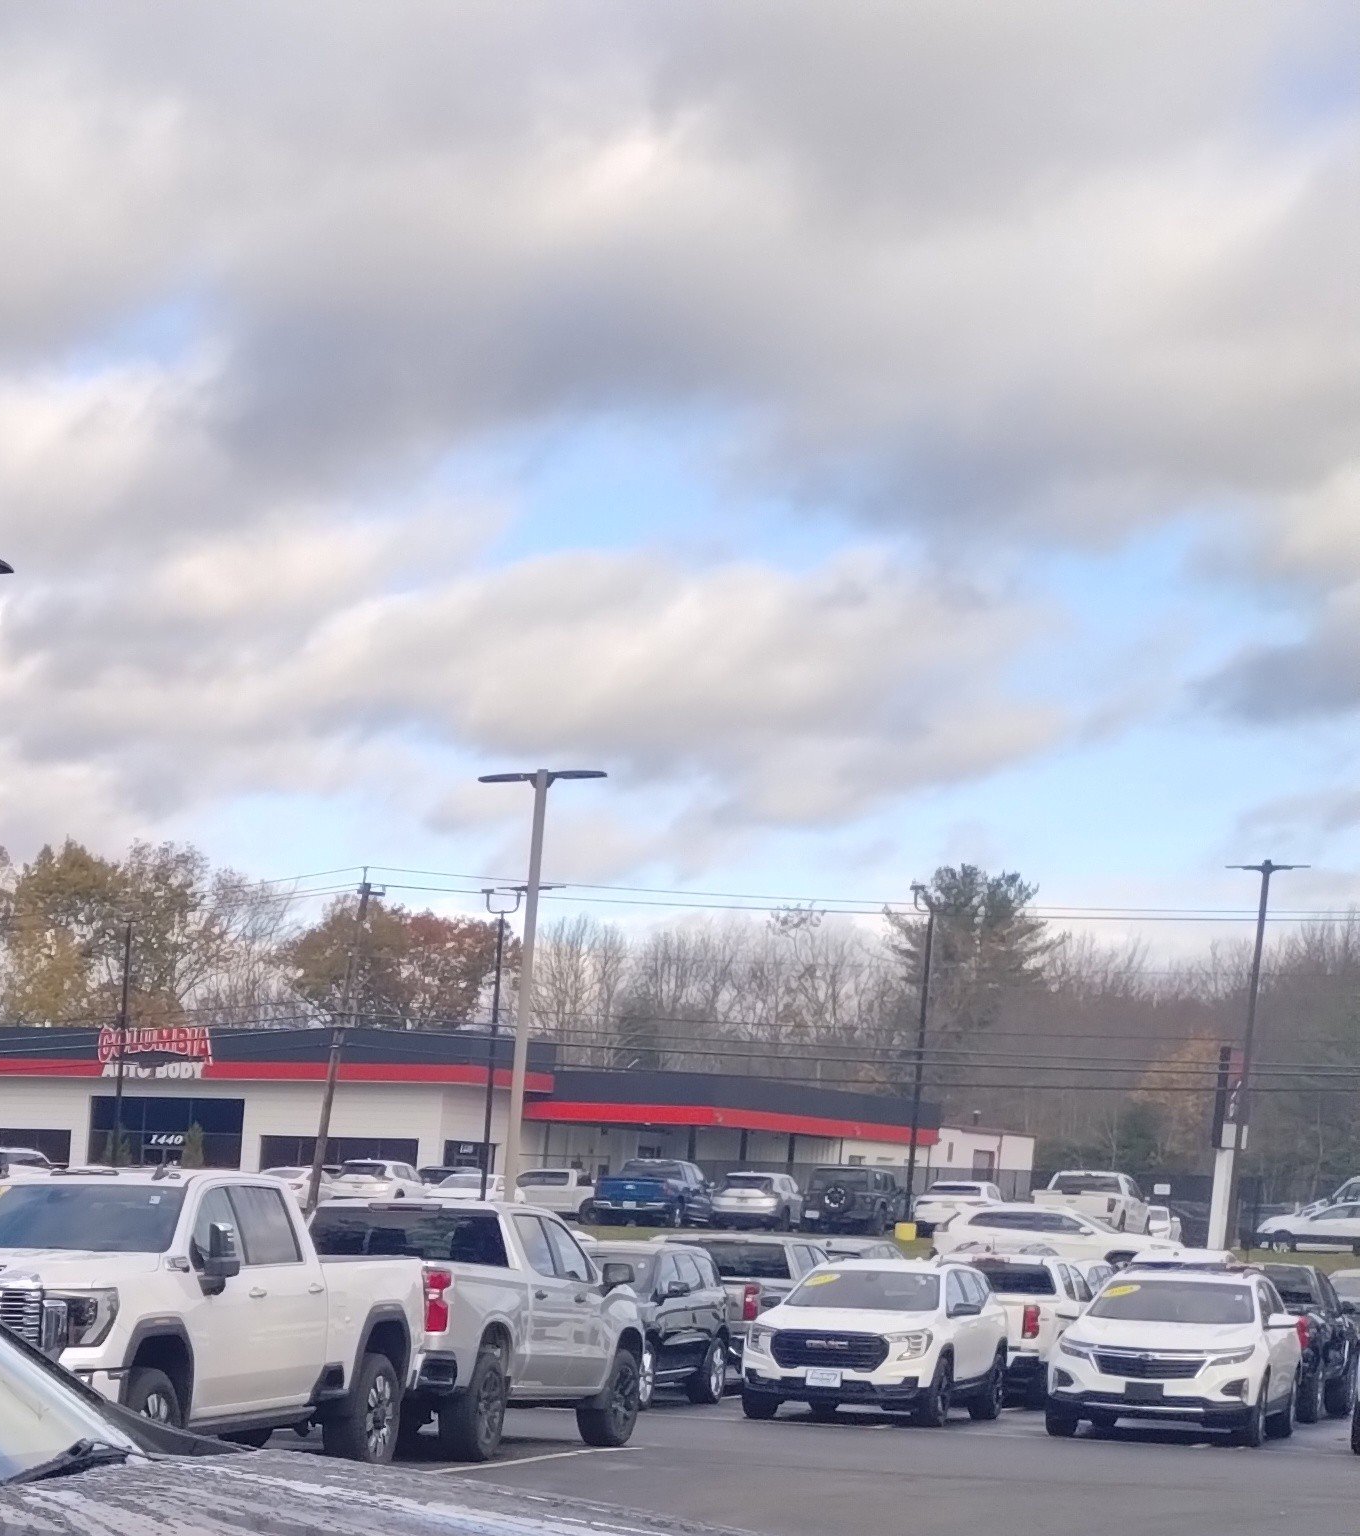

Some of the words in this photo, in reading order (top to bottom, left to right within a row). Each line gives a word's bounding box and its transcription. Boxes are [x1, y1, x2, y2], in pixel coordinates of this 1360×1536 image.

[98, 1025, 213, 1067] COLUMBIA
[155, 1060, 205, 1079] BODY
[149, 1133, 184, 1146] 1440
